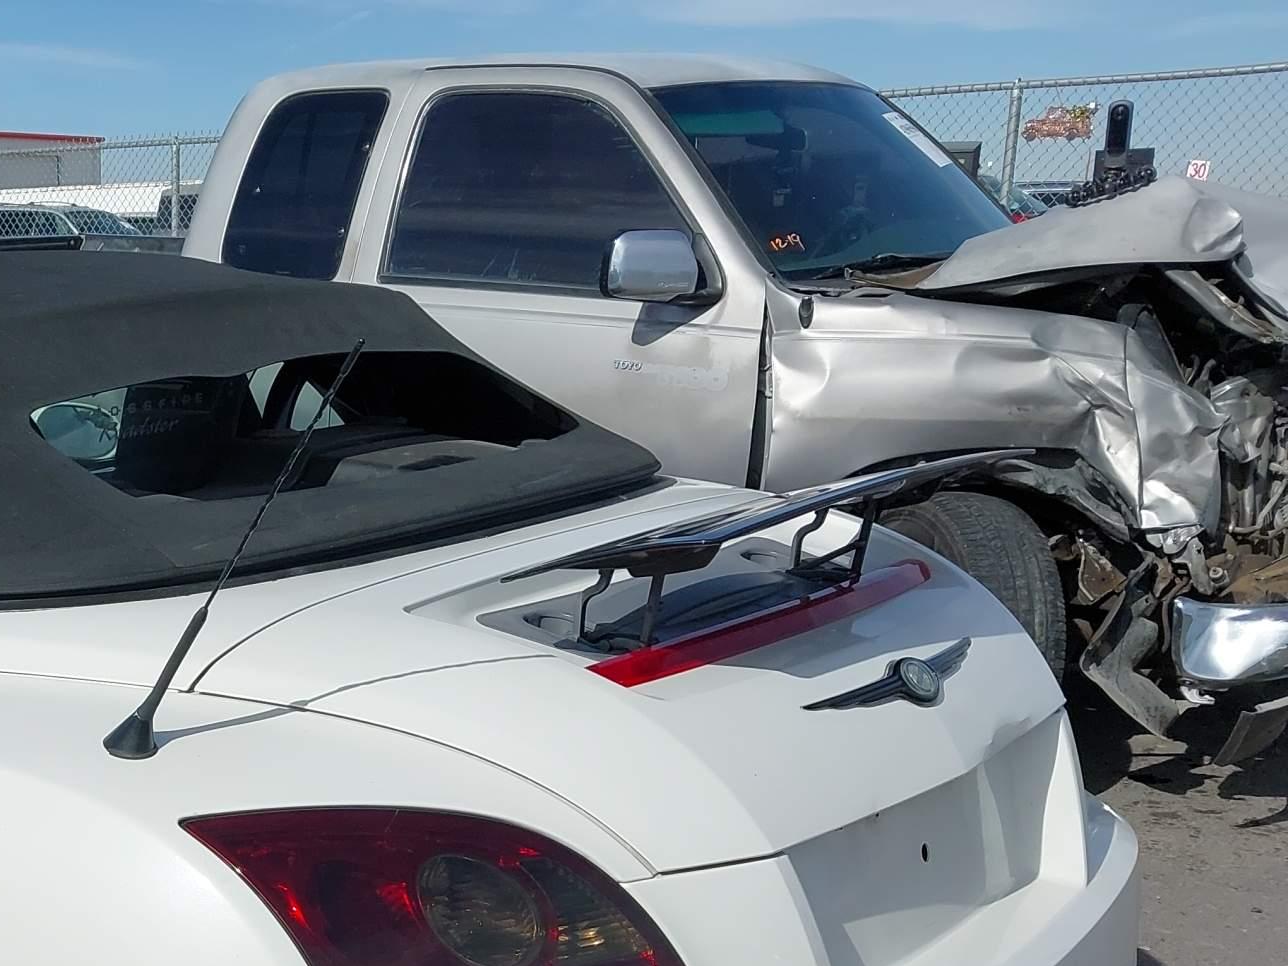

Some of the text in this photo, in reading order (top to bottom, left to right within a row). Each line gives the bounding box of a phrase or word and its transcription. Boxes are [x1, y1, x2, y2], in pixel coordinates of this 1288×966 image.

[1189, 162, 1207, 179] 30
[770, 233, 806, 251] 12-19
[614, 359, 643, 372] TOYO
